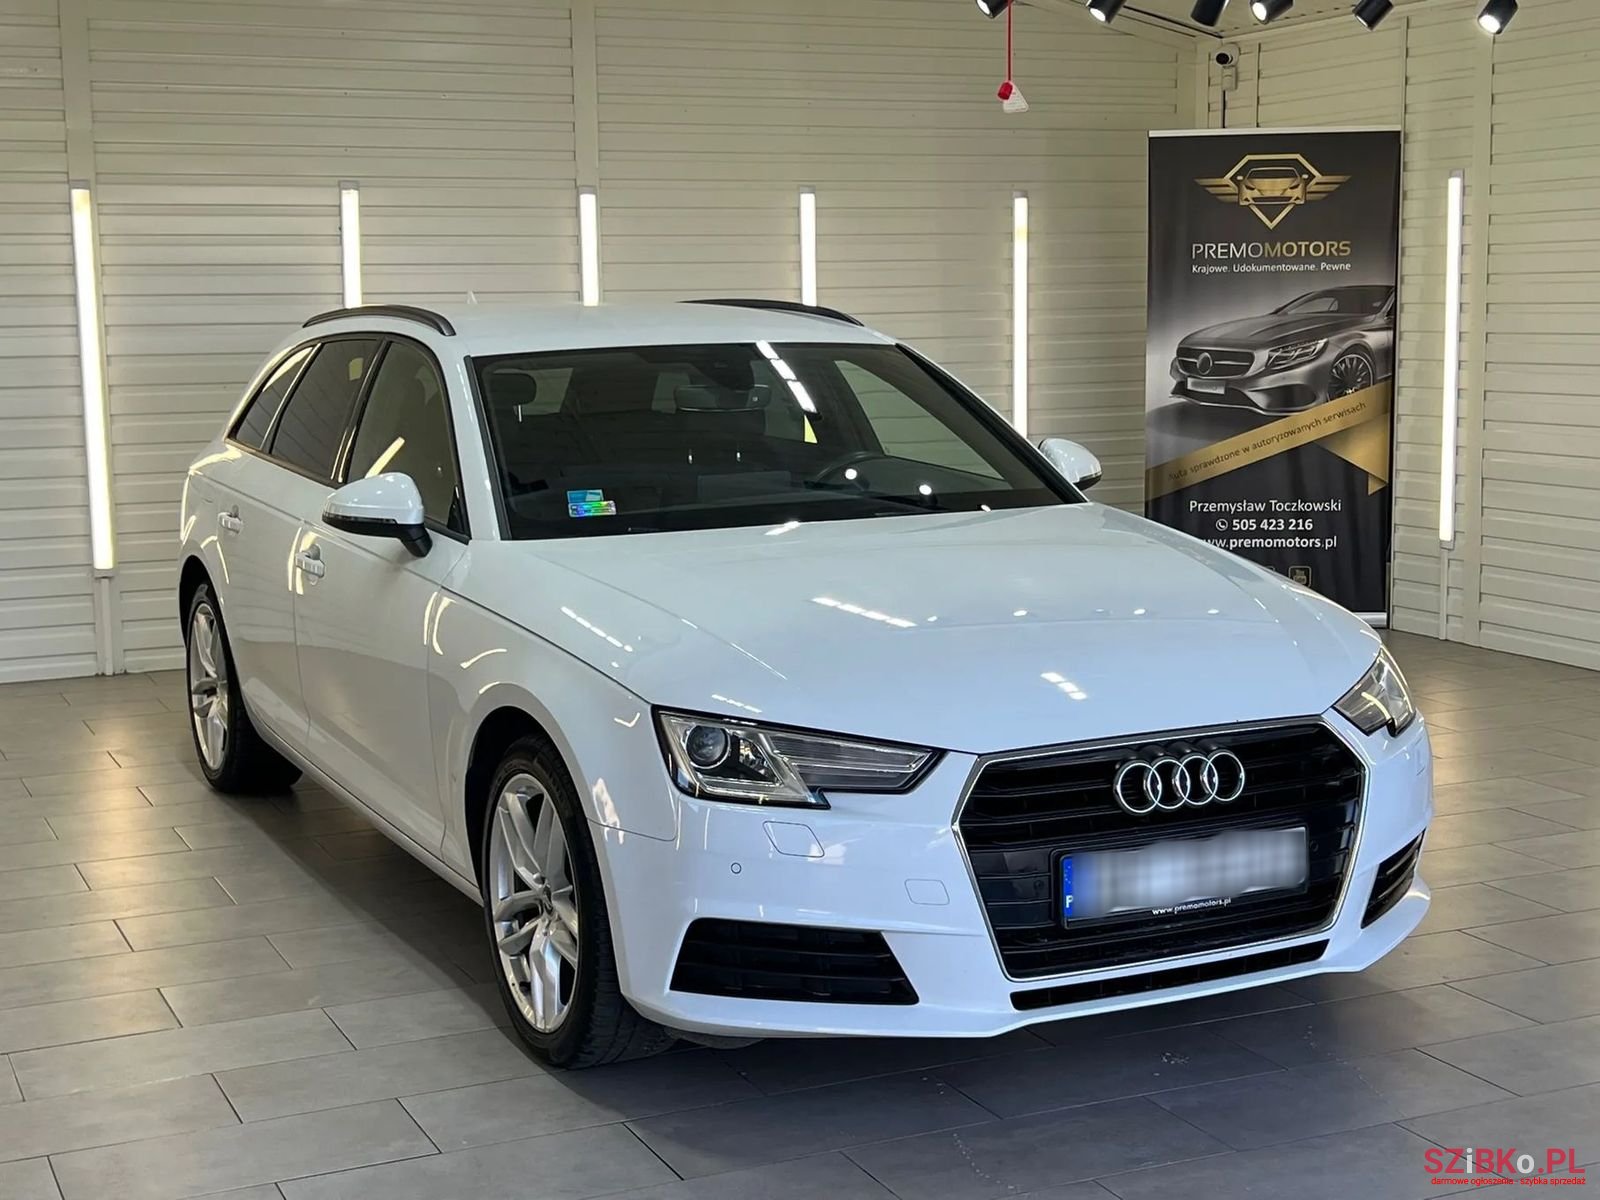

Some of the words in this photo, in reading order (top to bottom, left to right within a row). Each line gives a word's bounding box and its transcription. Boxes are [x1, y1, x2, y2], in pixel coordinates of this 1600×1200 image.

[1191, 241, 1351, 260] PREMOMOTORS
[1192, 264, 1230, 275] Krajowe.
[1233, 263, 1318, 273] Udokumentowane.
[1320, 262, 1351, 272] Pewne
[1168, 469, 1188, 482] Auta
[1189, 449, 1240, 473] sprawdzone
[1241, 446, 1251, 455] w
[1252, 418, 1321, 450] autoryzowanych
[1323, 401, 1366, 424] serwisach
[1189, 500, 1266, 514] Przemysław
[1269, 499, 1342, 512] Toczkowski
[1232, 518, 1257, 531] 505
[1260, 518, 1285, 531] 423
[1288, 518, 1313, 531] 216
[1203, 536, 1337, 550] w.premomotors.pl
[1065, 895, 1073, 909] P
[1152, 897, 1232, 915] www.premomotors.pl
